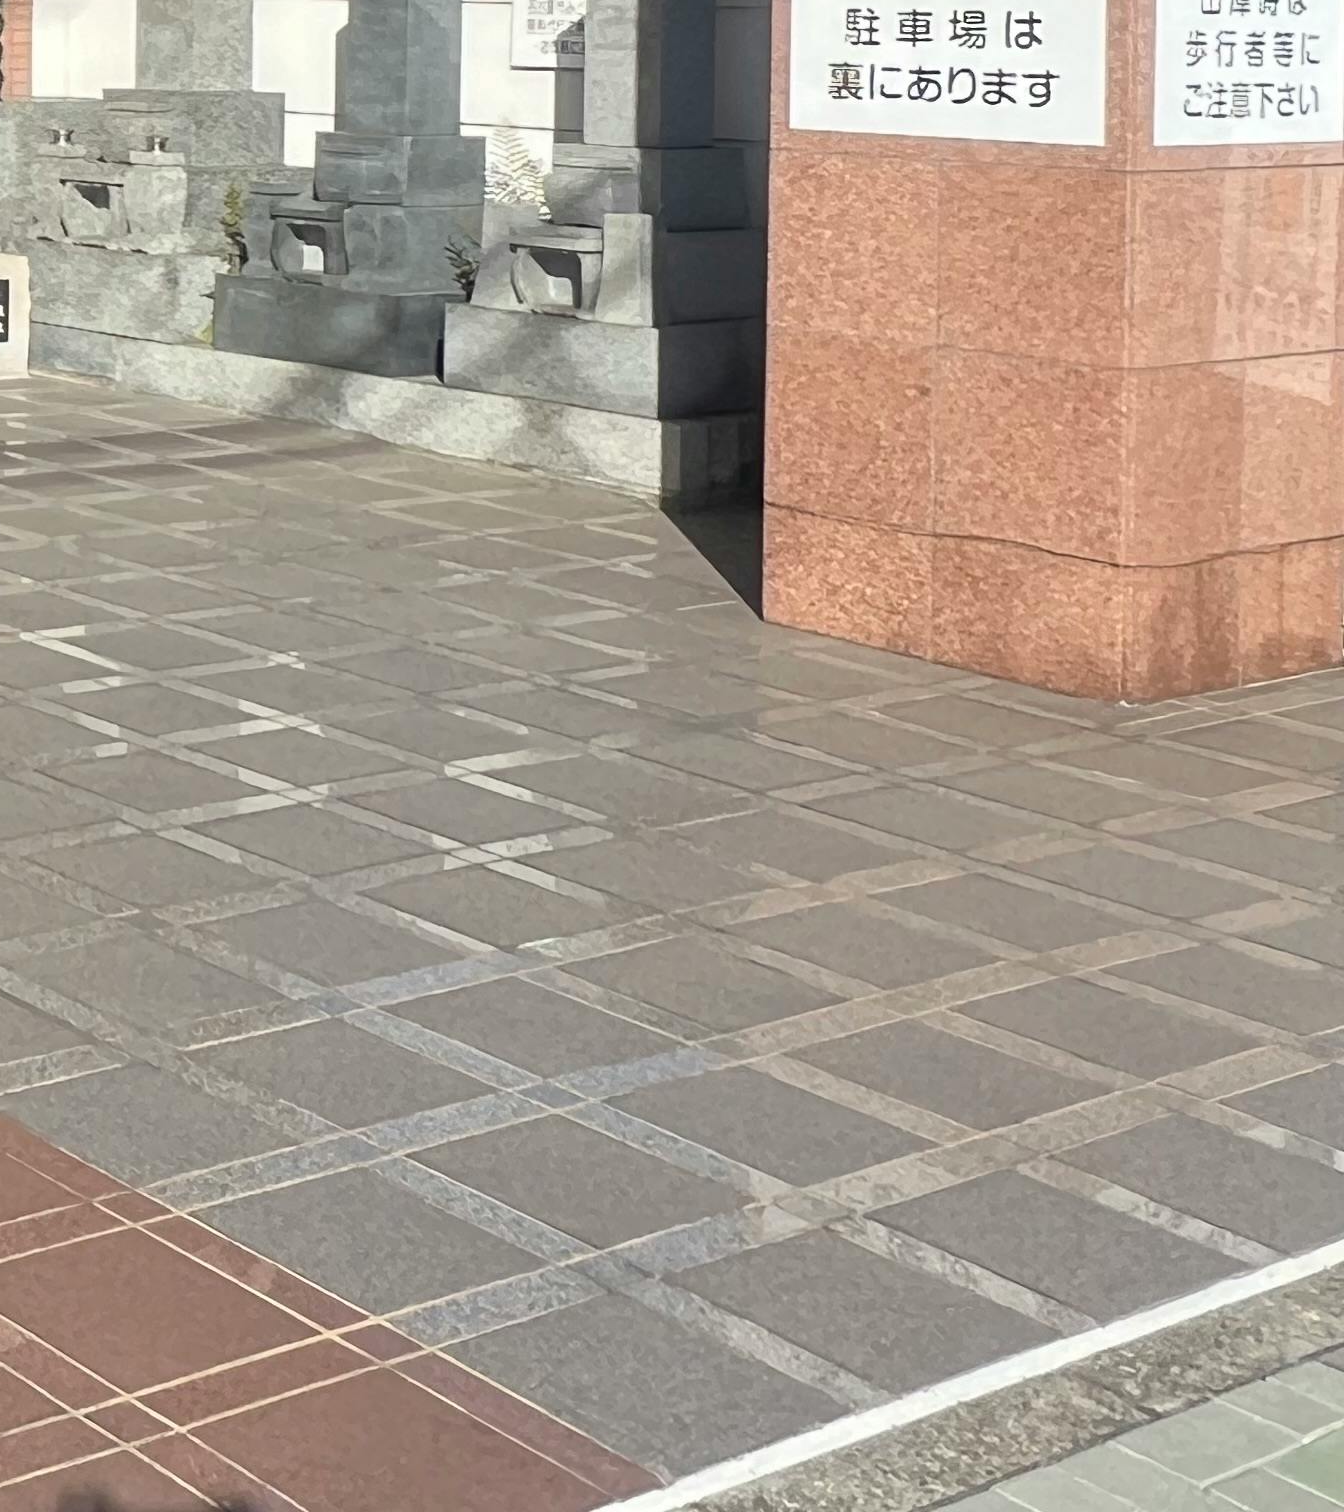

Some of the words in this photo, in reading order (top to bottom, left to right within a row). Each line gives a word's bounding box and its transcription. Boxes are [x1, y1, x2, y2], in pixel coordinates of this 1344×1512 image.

[846, 8, 1043, 50] 駐車場は
[1185, 30, 1321, 67] 歩行者等に
[827, 61, 1060, 108] 裏にあります
[1183, 82, 1319, 119] ご注意下さい
